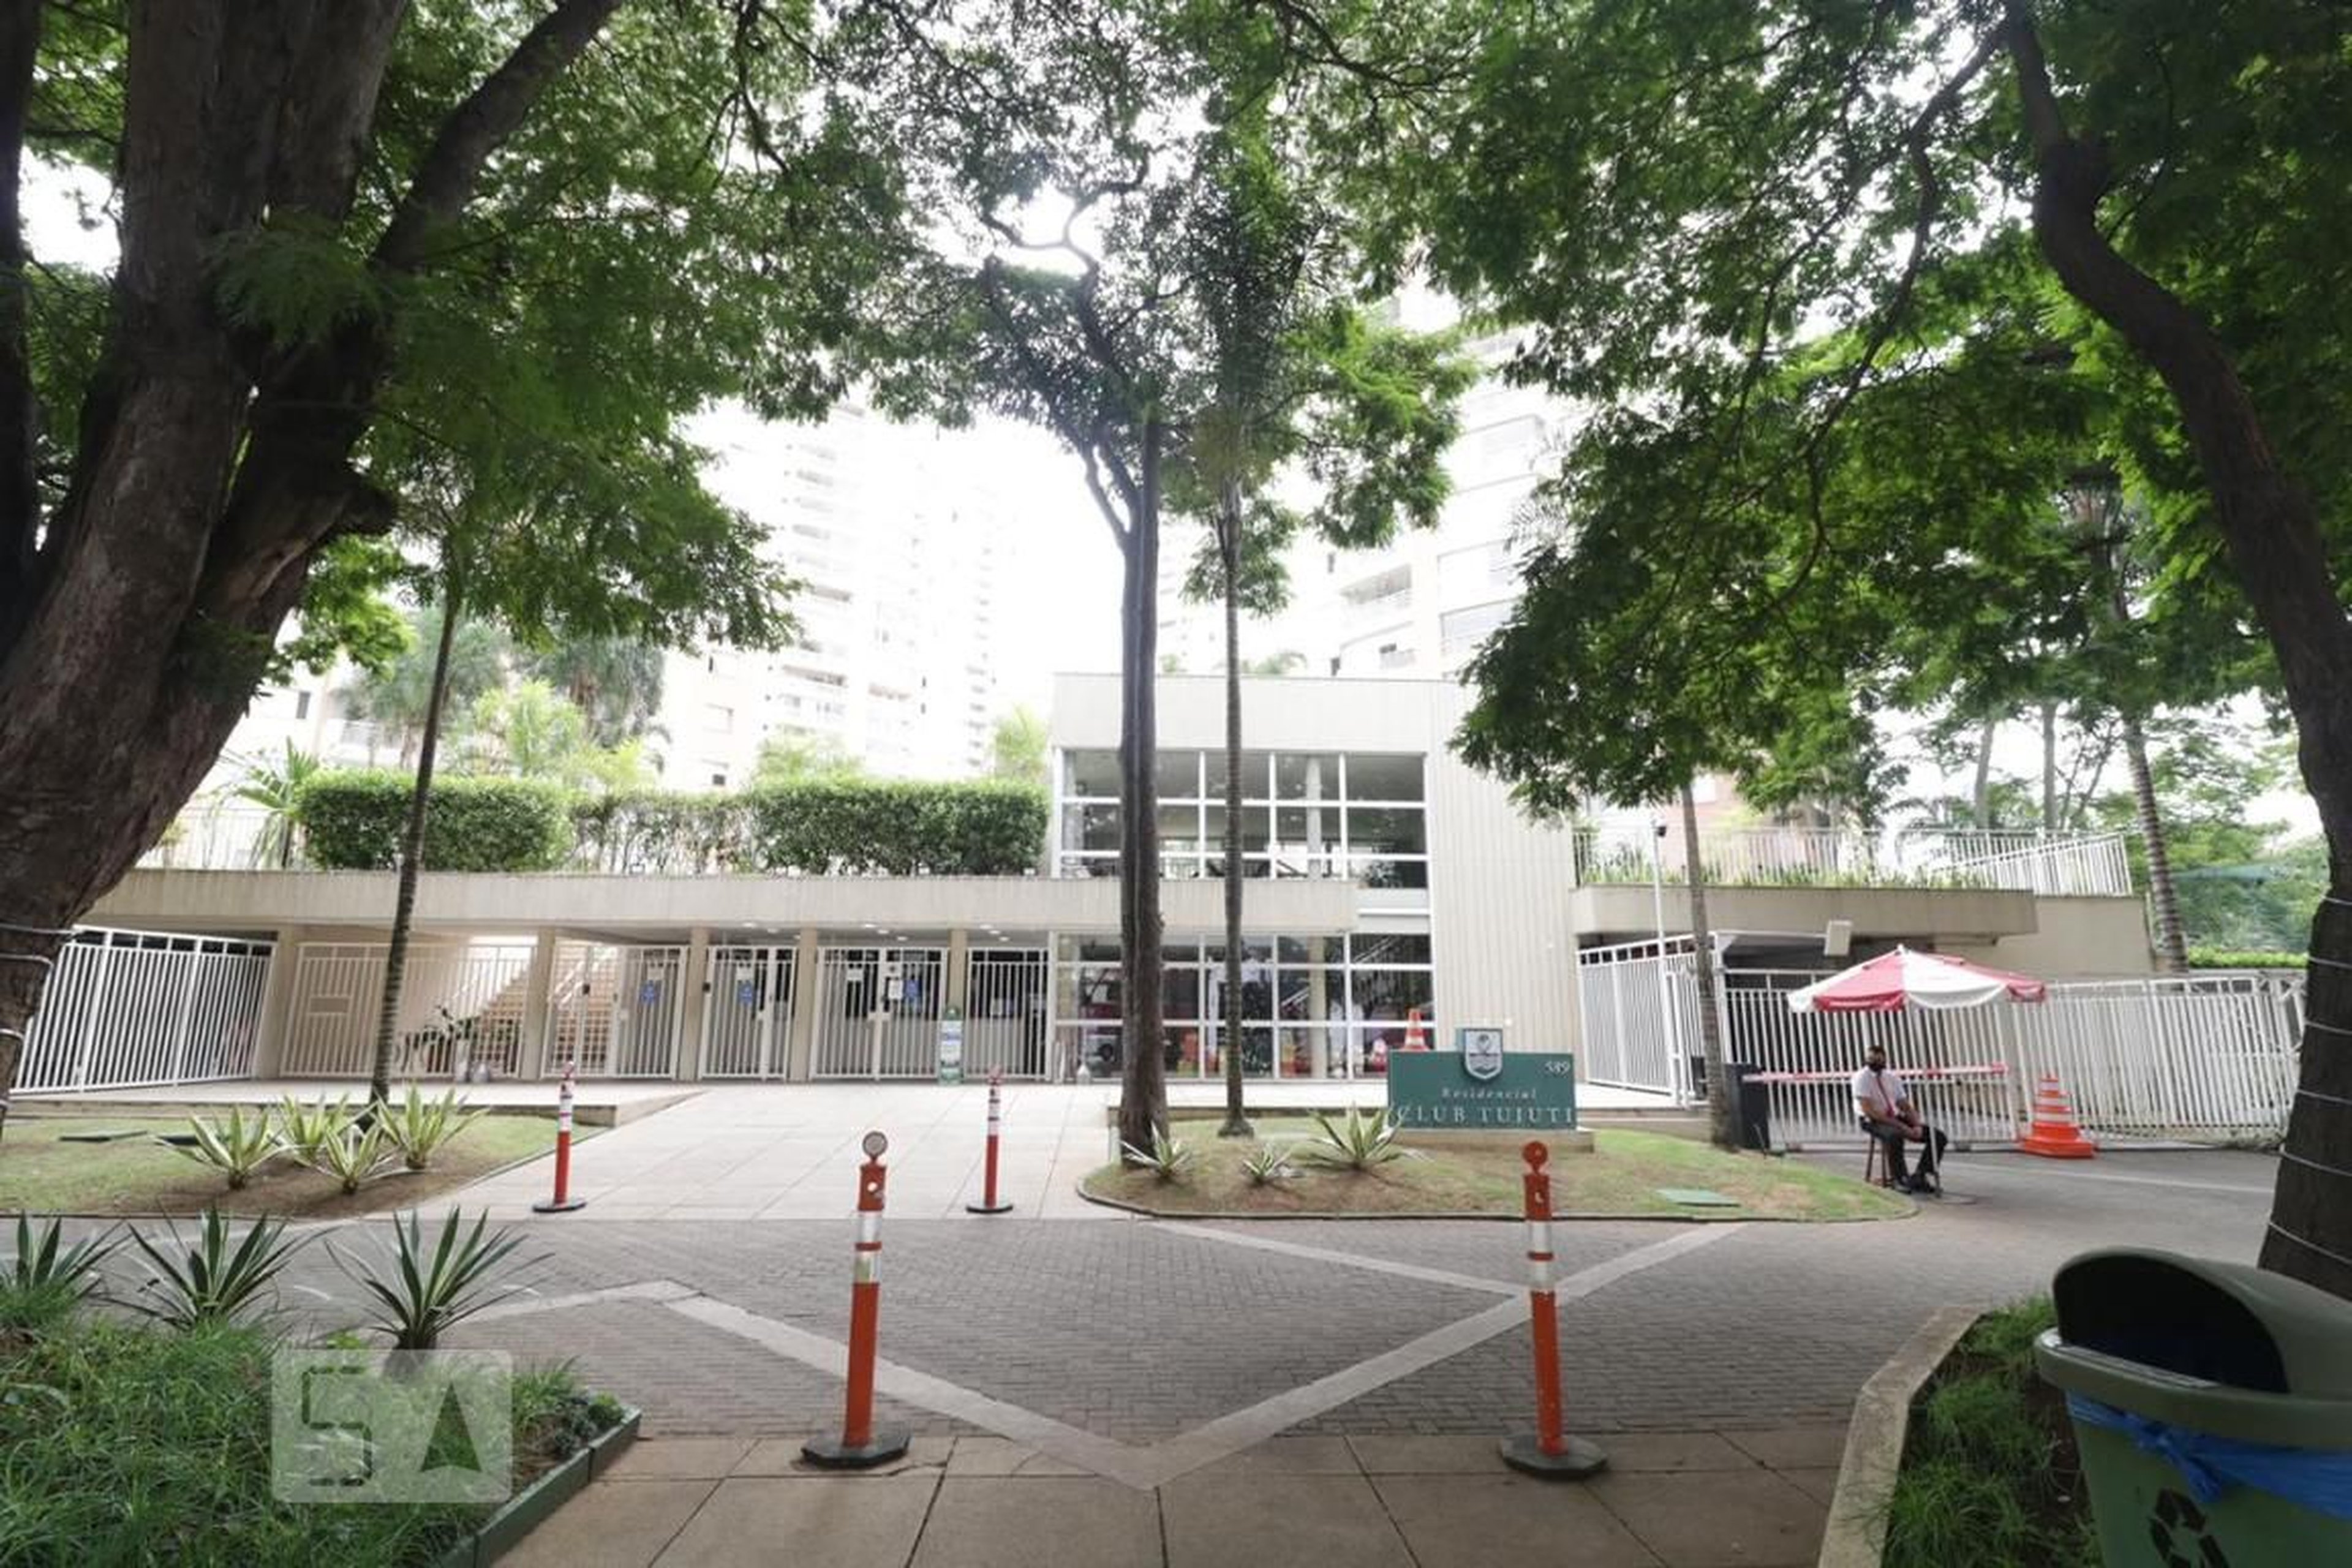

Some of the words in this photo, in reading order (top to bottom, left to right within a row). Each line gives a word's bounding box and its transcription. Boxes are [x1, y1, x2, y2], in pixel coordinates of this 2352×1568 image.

[1441, 1087, 1536, 1099] Residencial
[1397, 1105, 1468, 1123] CLUB
[1476, 1106, 1572, 1123] TUIUTI
